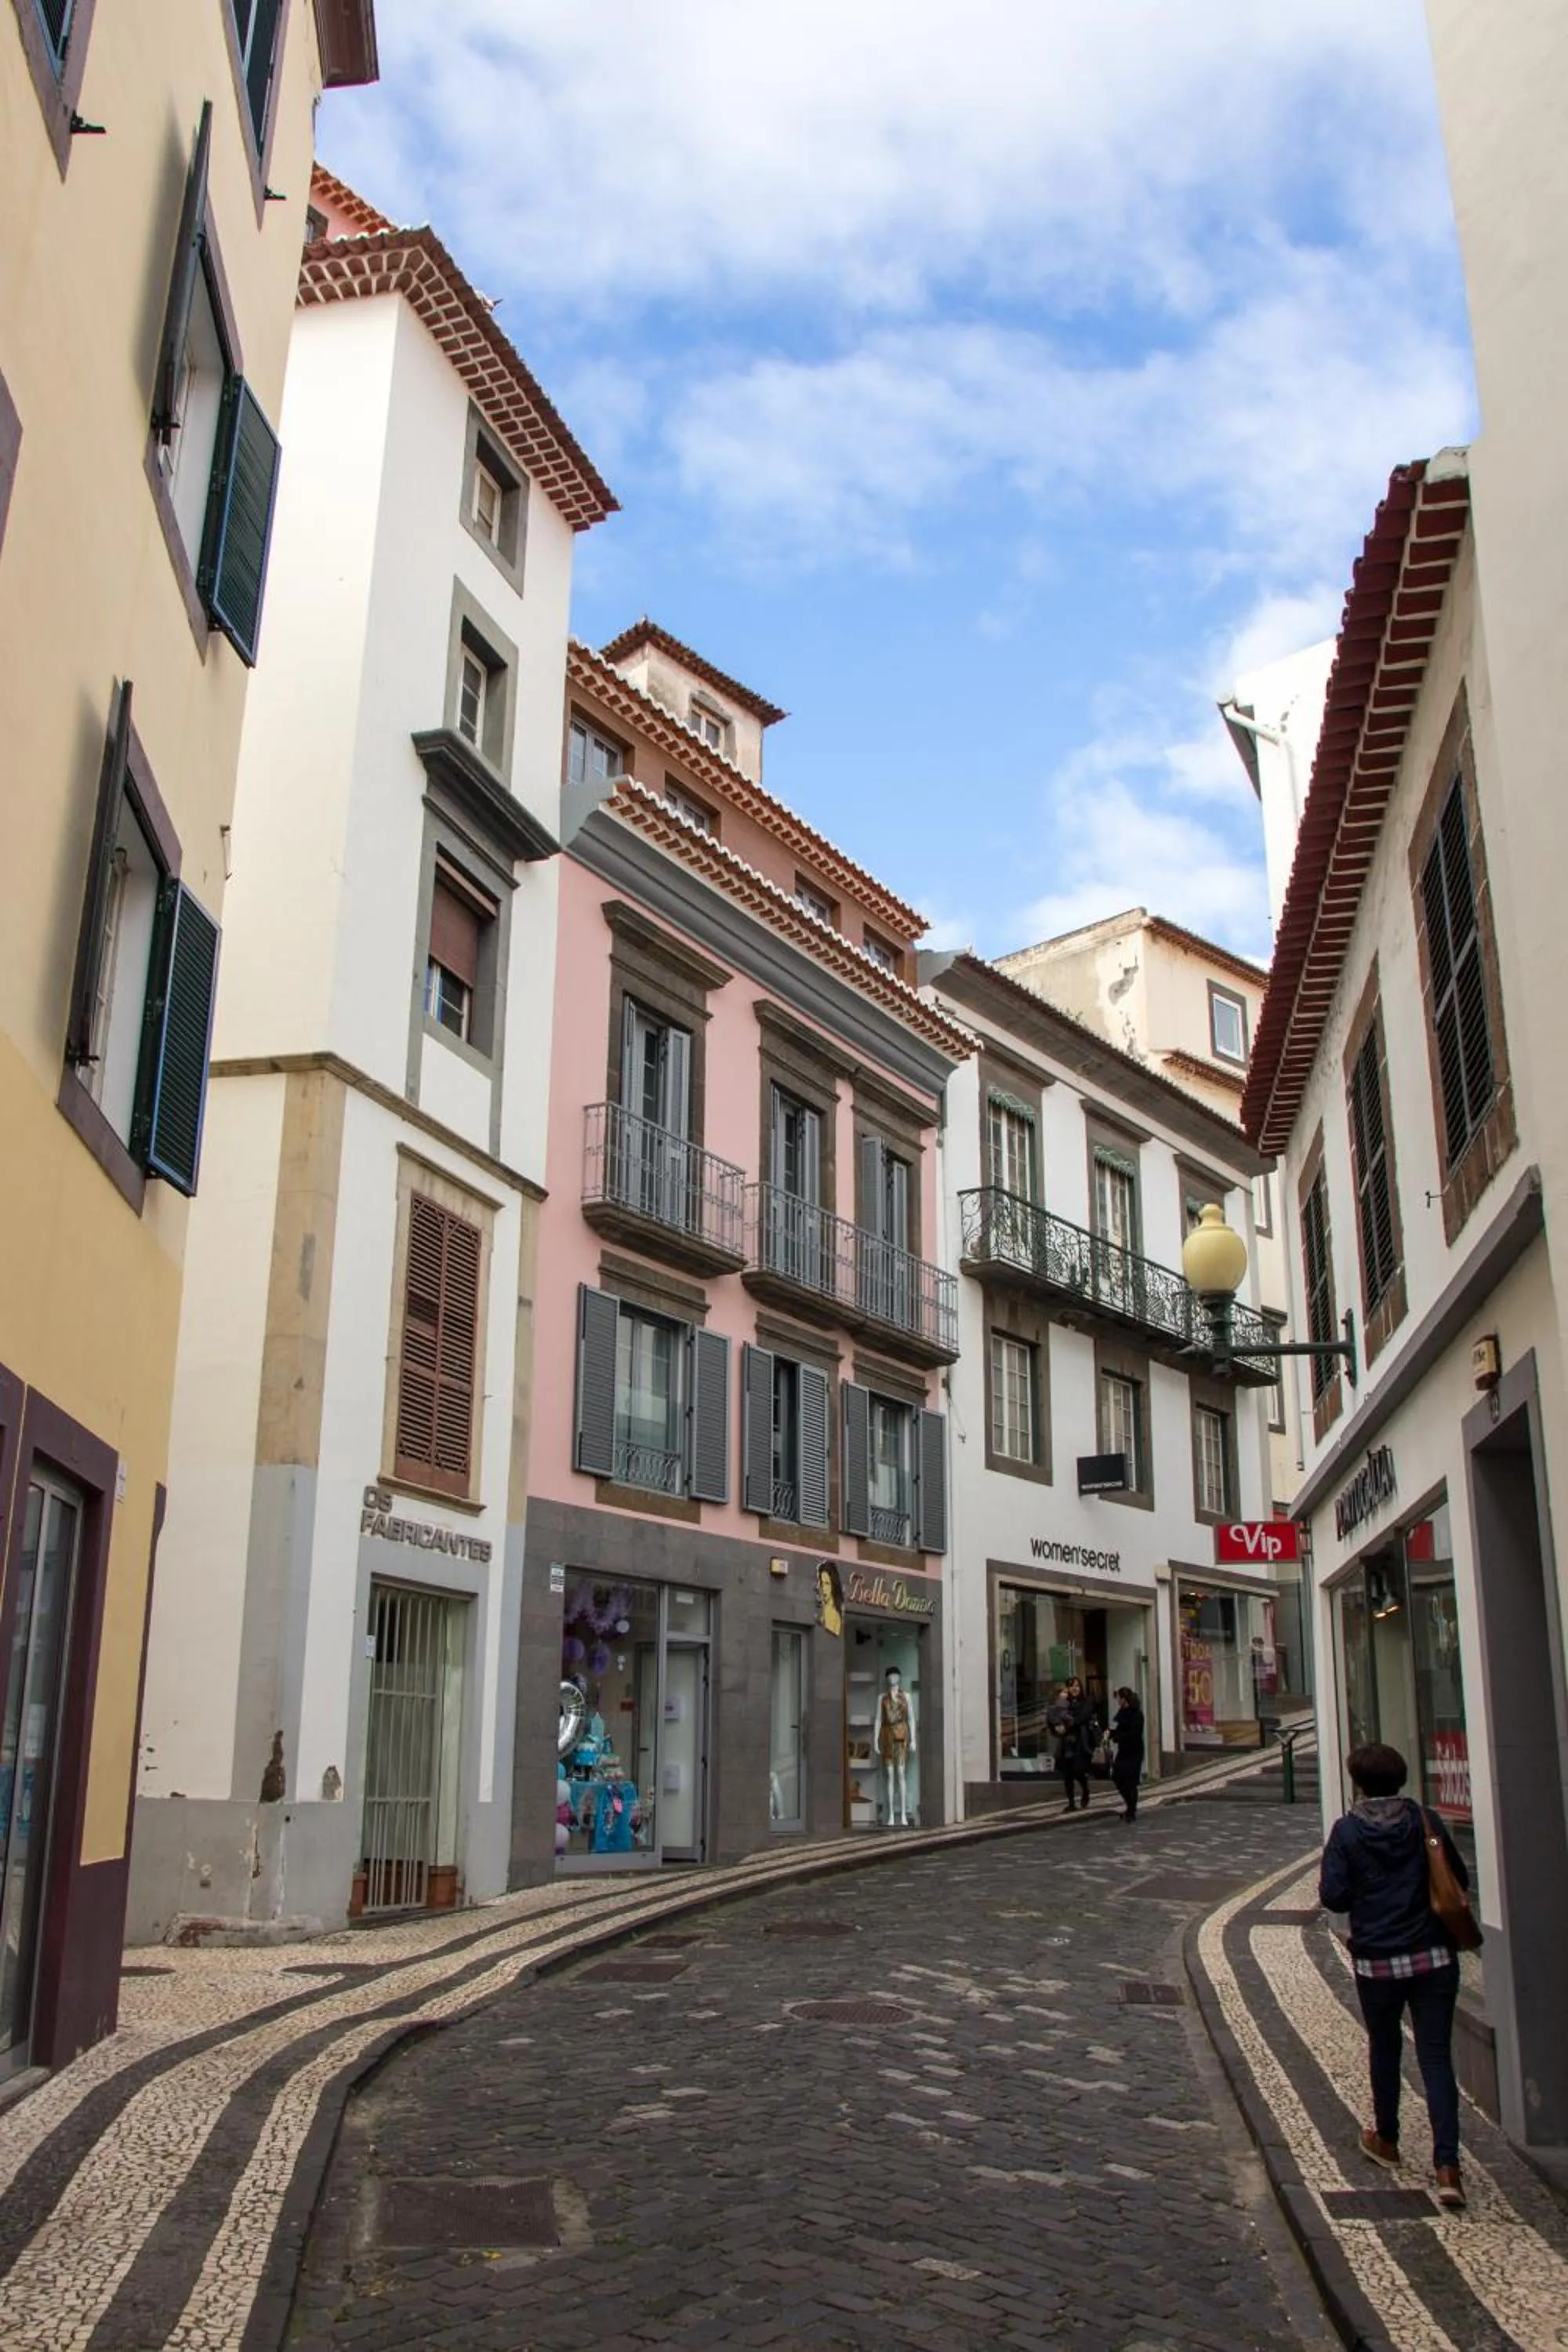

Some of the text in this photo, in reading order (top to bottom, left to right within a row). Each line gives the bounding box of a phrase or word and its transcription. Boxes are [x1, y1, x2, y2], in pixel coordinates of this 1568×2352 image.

[361, 1510, 492, 1563] FABRICANTES
[1030, 1537, 1121, 1572] women'secret
[1229, 1523, 1282, 1561] Vip
[849, 1571, 891, 1609] Bella
